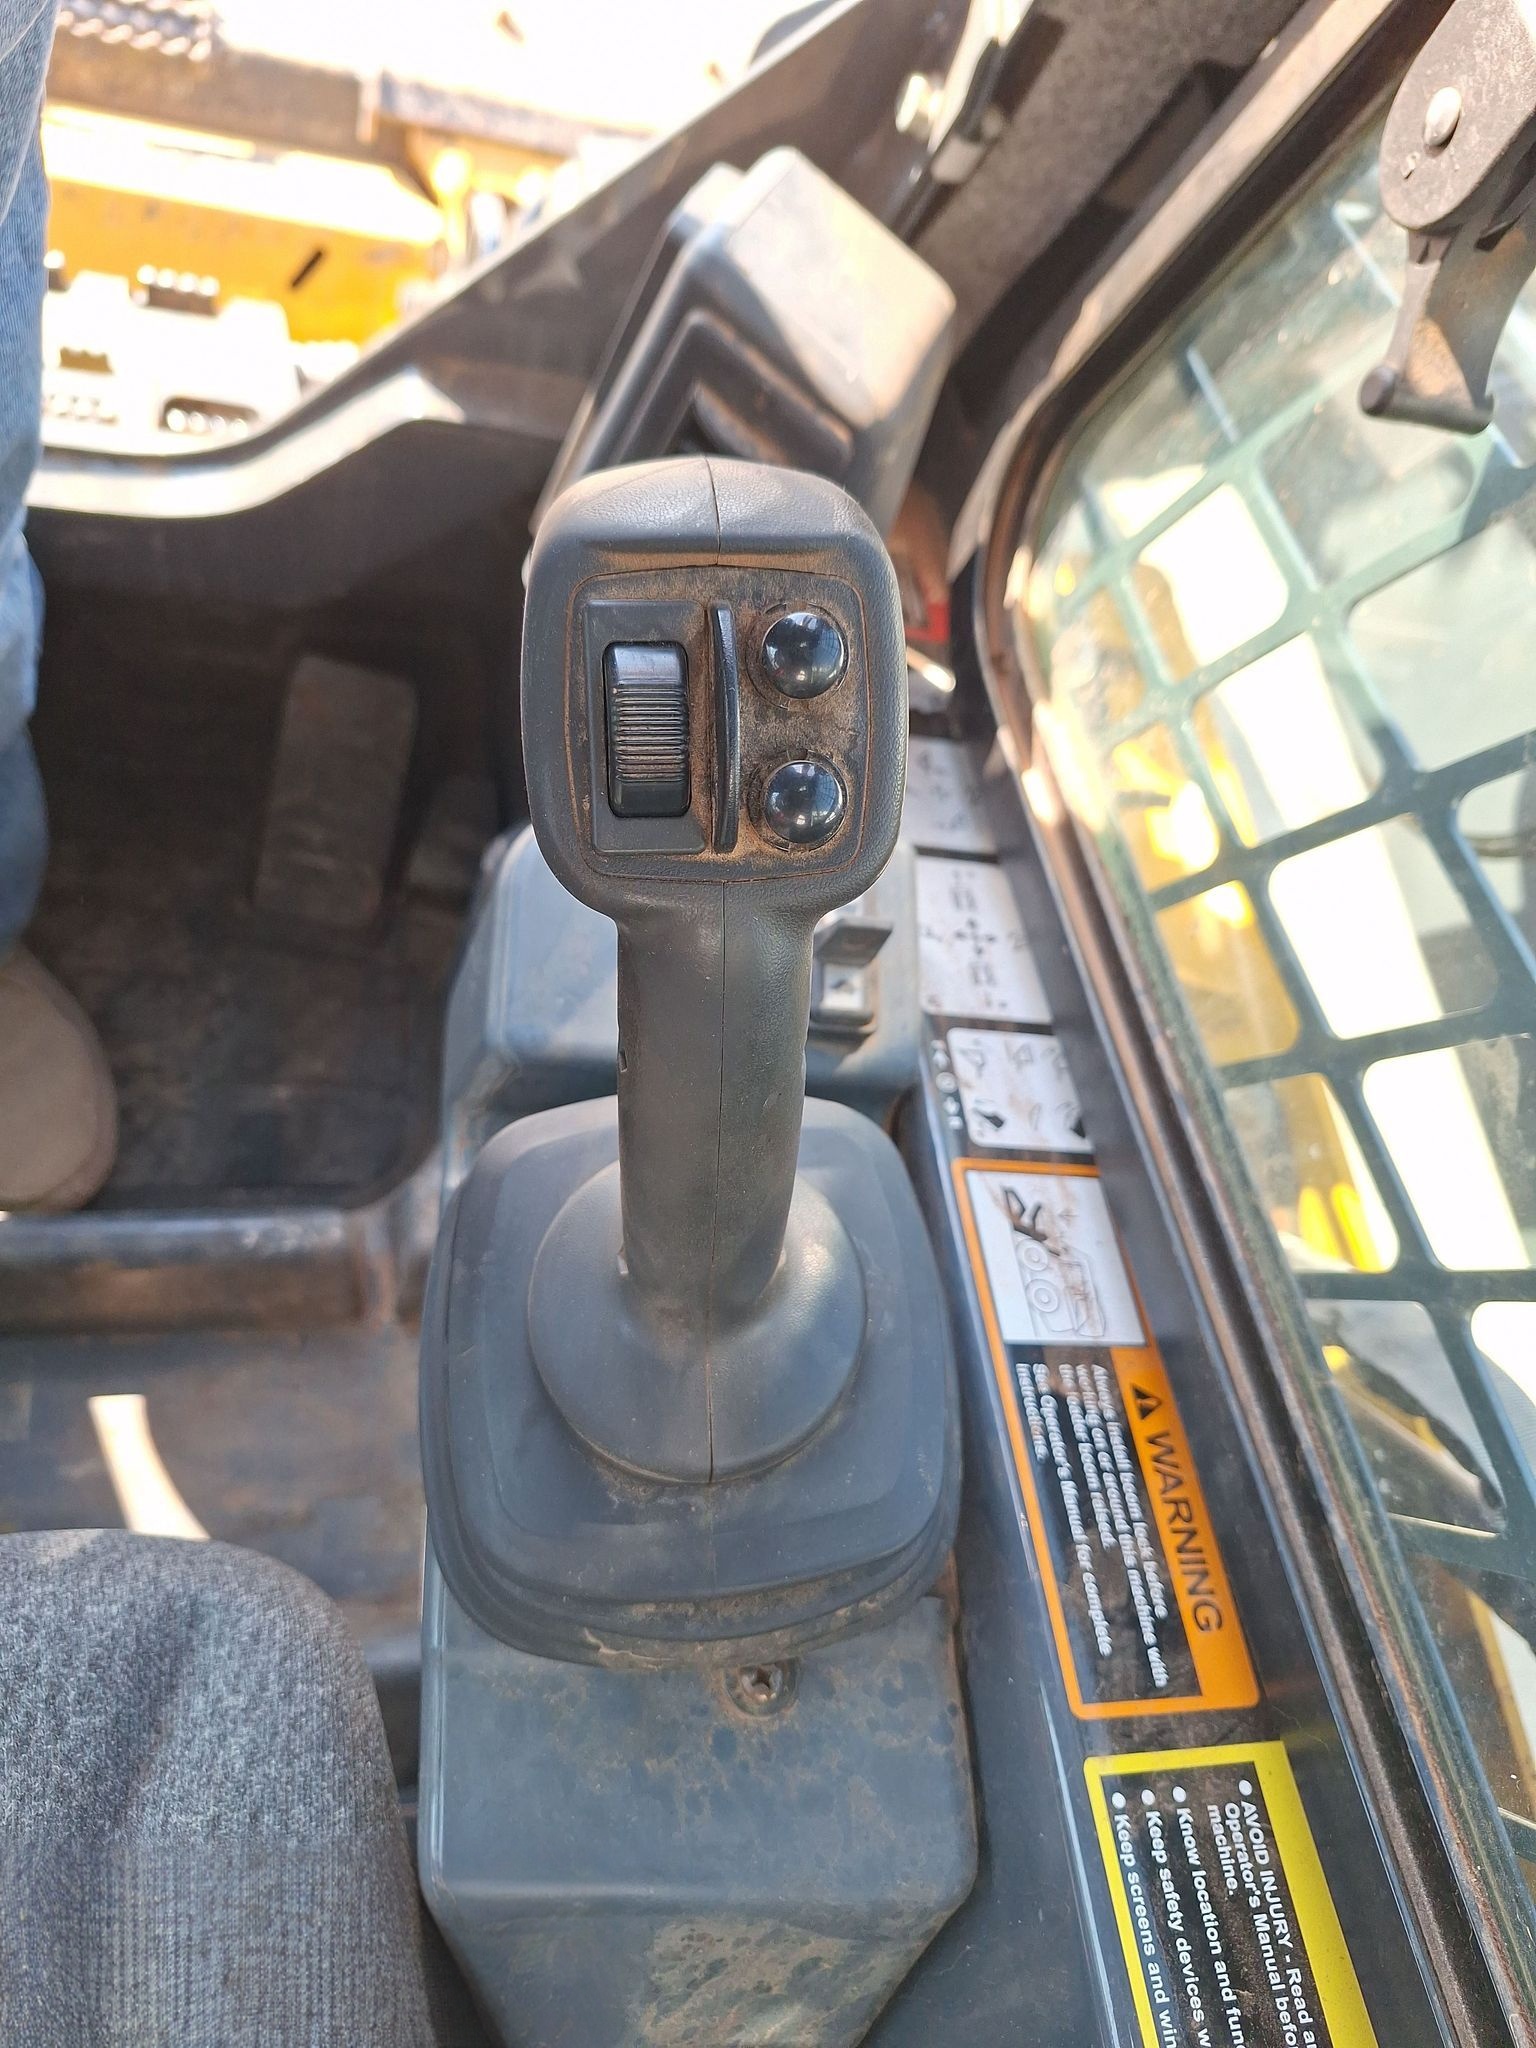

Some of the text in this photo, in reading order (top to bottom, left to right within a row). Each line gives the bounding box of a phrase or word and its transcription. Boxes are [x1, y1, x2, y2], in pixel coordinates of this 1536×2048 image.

[1058, 1364, 1077, 1390] the
[1078, 1443, 1102, 1491] boom
[1074, 1364, 1100, 1428] working
[1091, 1428, 1109, 1451] on
[1033, 1364, 1113, 1657] See Operator's Manual for complete
[1091, 1365, 1168, 1619] Always install boom lock before
[1102, 1472, 1133, 1534] around
[1118, 1534, 1138, 1568] this
[1146, 1430, 1224, 1631] WARNING
[1127, 1569, 1157, 1646] machine
[1147, 1647, 1169, 1688] with
[1113, 1814, 1135, 1867] Keep
[1127, 1872, 1156, 1956] screens
[1147, 1962, 1170, 2004] and
[1145, 1811, 1169, 1864] Keep
[1158, 1868, 1184, 1931] safety
[1175, 1937, 1205, 2023] devices
[1176, 1807, 1246, 2048] Know location and fun
[1207, 1804, 1238, 1896] machine.
[1224, 1802, 1299, 2048] Operator's Manual befo
[1241, 1801, 1270, 1865] AVOID
[1260, 1870, 1293, 1948] INJURY
[1286, 1968, 1314, 2024] Read
